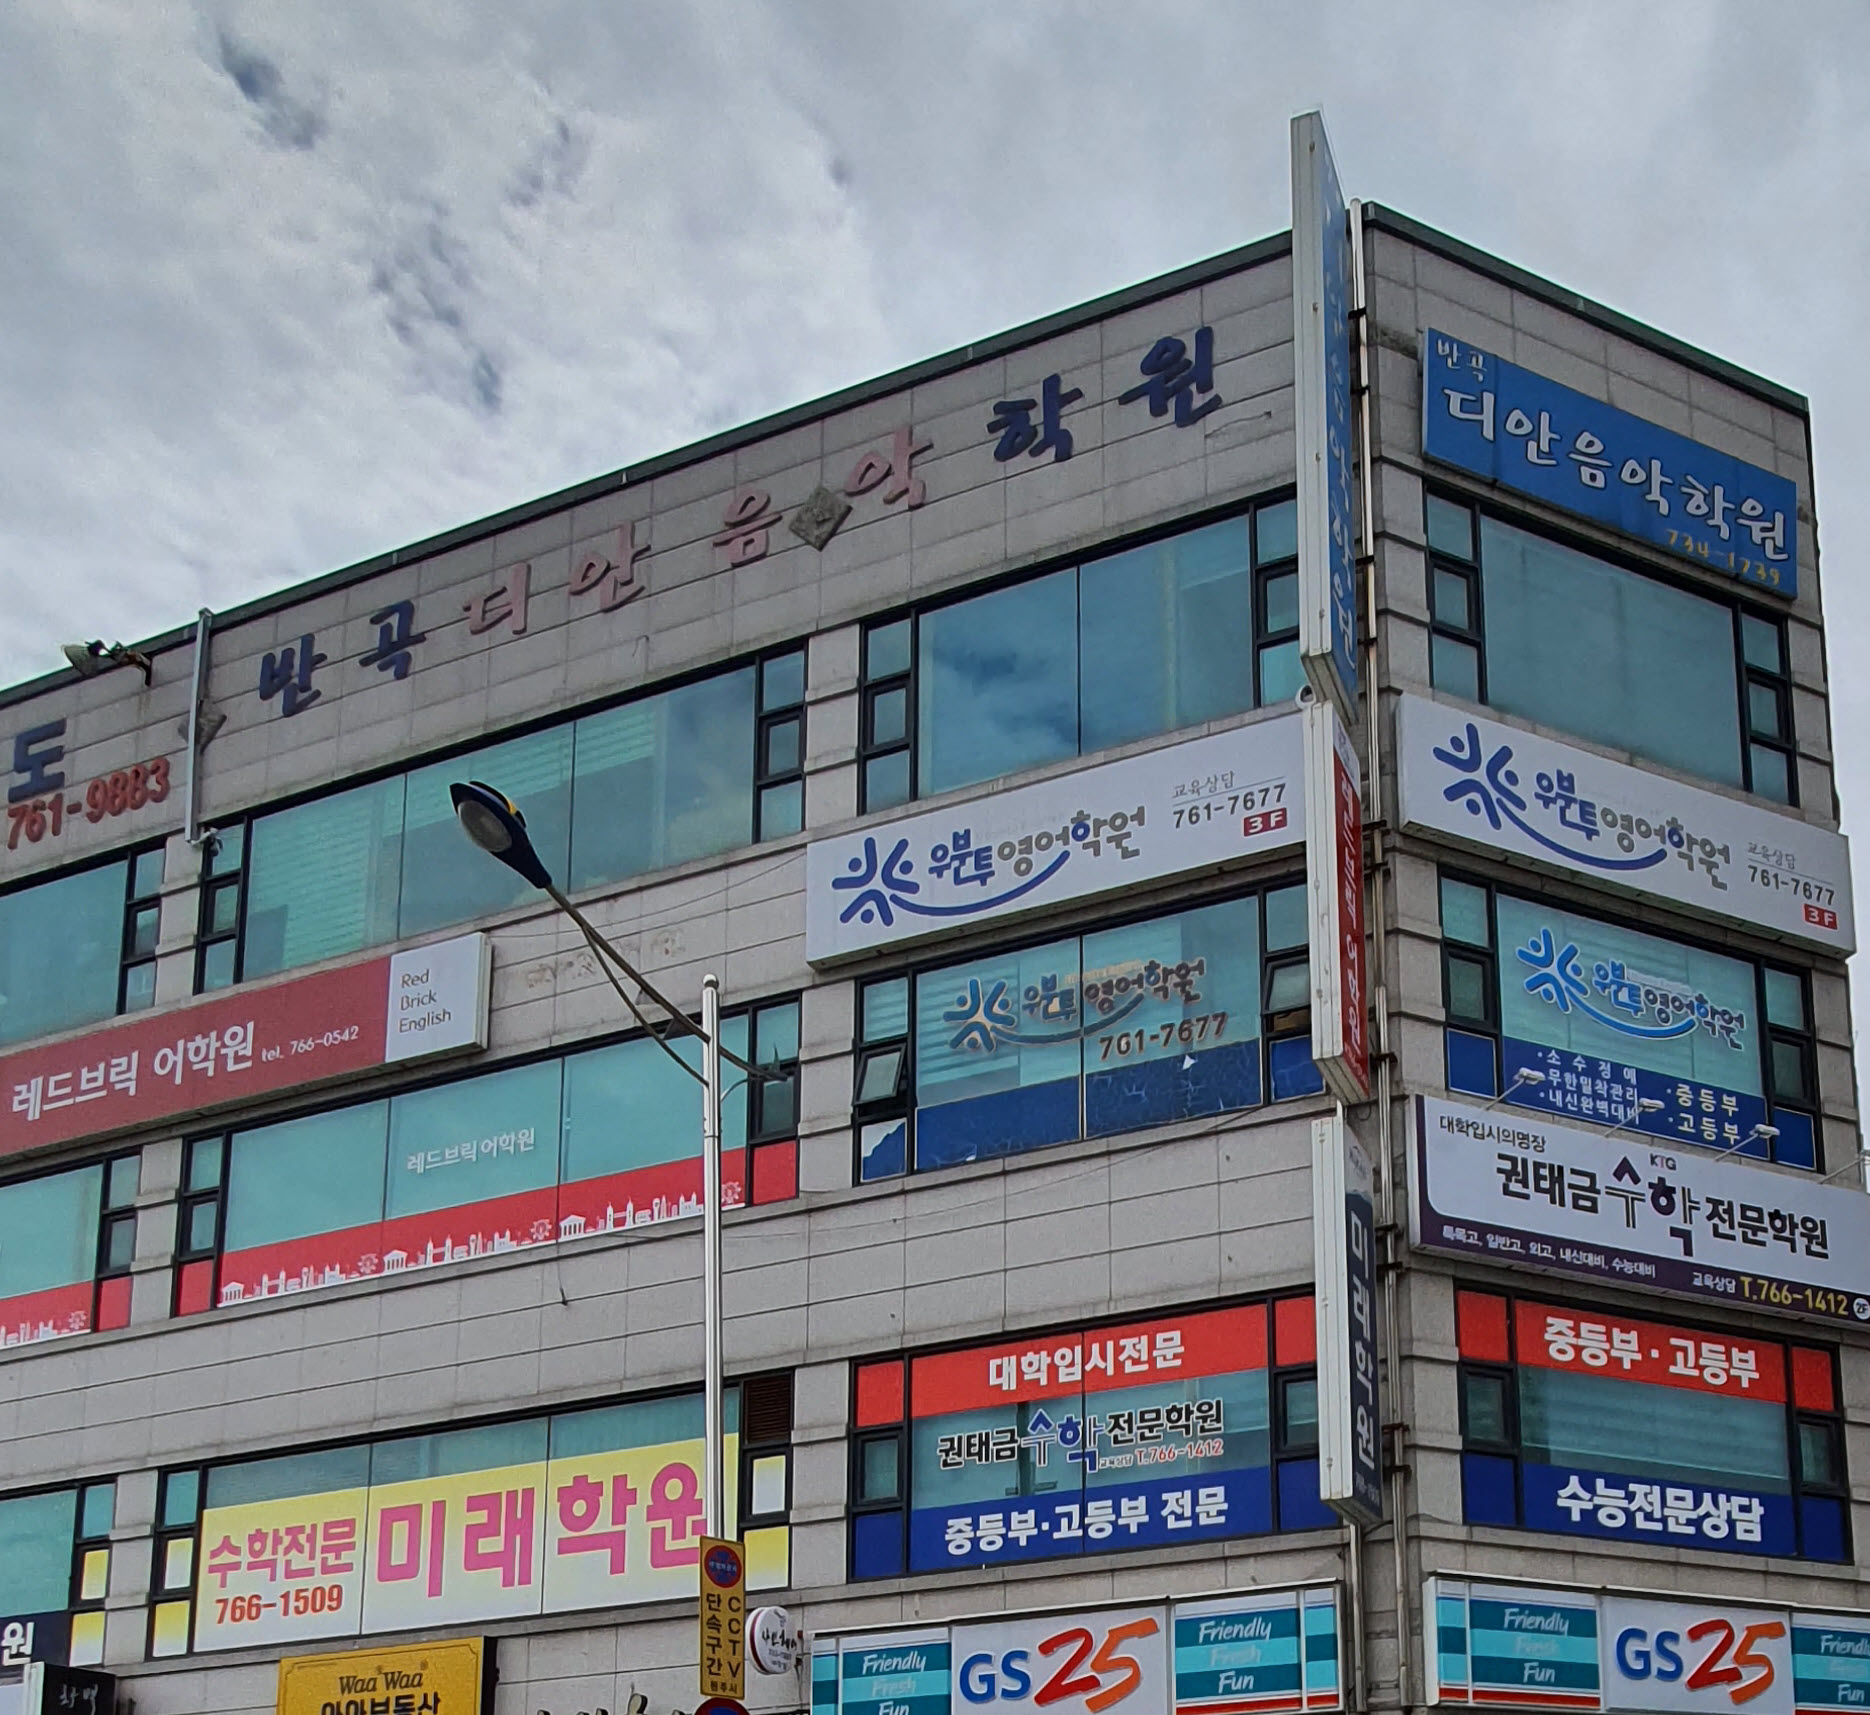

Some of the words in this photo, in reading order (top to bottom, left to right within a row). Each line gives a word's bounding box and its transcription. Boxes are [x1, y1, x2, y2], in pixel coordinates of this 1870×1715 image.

[1437, 339, 1489, 382] 반곡
[1443, 389, 1789, 561] 디안음악학원
[1172, 770, 1236, 799] 교육상담
[7, 757, 170, 850] 761-9883
[1172, 783, 1287, 829] 761-7677
[1747, 841, 1796, 868] 교육상담
[1749, 865, 1835, 906] 761-7677
[401, 969, 429, 988] Red
[400, 989, 438, 1011] Brick
[399, 1008, 452, 1033] English
[12, 1051, 140, 1122] 레드브릭
[153, 1021, 255, 1086] 어학원
[262, 1046, 284, 1062] tel.
[290, 1025, 360, 1055] 766-0542
[1675, 1084, 1738, 1116] 중등부
[1440, 1115, 1546, 1152] 대학입시의명장
[1678, 1114, 1740, 1144] 고등부
[1650, 1153, 1677, 1171] KTG
[1351, 1209, 1375, 1471] 미래학원
[988, 1330, 1185, 1391] 대학입시전문
[1160, 1486, 1228, 1530] 전문
[1557, 1475, 1764, 1542] 수능전문상담
[207, 1517, 357, 1590] 수학전문
[215, 1583, 343, 1626] 766-1509
[706, 1593, 722, 1676] 단속구간
[1199, 1616, 1272, 1644] Friendly
[1504, 1607, 1569, 1637] Friendly
[1821, 1634, 1870, 1656] Friendl
[862, 1650, 927, 1676] Friendly
[959, 1617, 1160, 1714] GS25
[1523, 1662, 1555, 1683] Fun
[1616, 1619, 1786, 1705] GS25
[339, 1676, 377, 1695] Waa
[382, 1671, 423, 1691] Waa
[710, 1680, 738, 1695] 원주시
[1218, 1670, 1254, 1694] Fun
[1838, 1684, 1865, 1703] Fun
